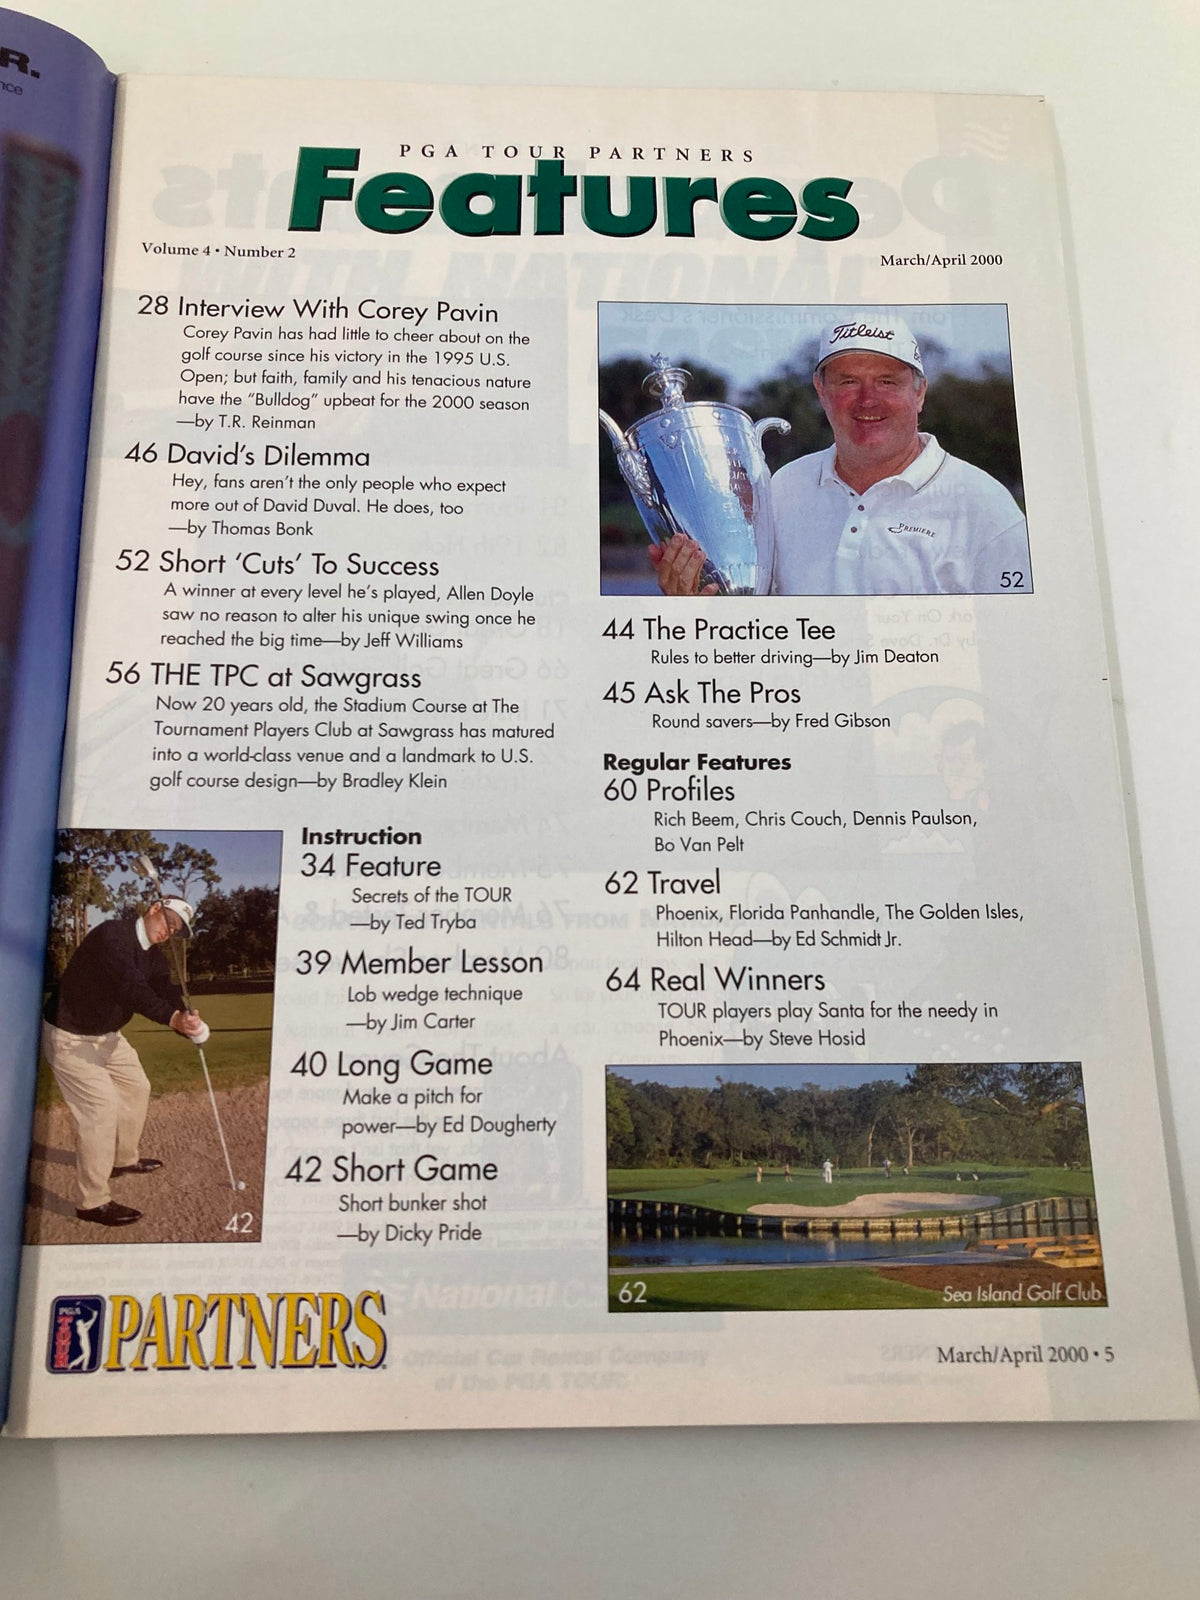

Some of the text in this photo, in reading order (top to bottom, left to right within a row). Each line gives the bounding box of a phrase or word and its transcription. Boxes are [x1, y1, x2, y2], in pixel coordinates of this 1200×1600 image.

[400, 144, 752, 162] PGA TOUR PARTNERS
[288, 146, 860, 242] Features
[142, 243, 295, 258] Volume 4 Number 2
[881, 254, 1002, 268] March/April 2000
[138, 295, 497, 326] 28 Interview With Corey Pavin
[184, 325, 529, 345] Corey Pavin has had little to cheer about on the
[829, 322, 895, 344] Titleist
[182, 346, 509, 366] golf course since his victory in the 1995 U.S.
[125, 442, 157, 463] 46
[265, 442, 369, 466] Dilemma
[171, 497, 463, 516] more out of David Duval. He does, too
[116, 549, 149, 571] 52
[160, 548, 226, 573] Short
[312, 553, 337, 574] To
[347, 553, 439, 576] Success
[1000, 571, 1025, 589] 52
[602, 615, 835, 640] 44 The Practice Tee
[106, 661, 421, 694] 56 THE TPC at Sawgrass
[603, 679, 801, 704] 45 Ask The Pros
[157, 696, 519, 716] Now 20 years old, the Stadium Course at The
[154, 721, 554, 742] Tournament Players Club at Sawgrass has matured
[604, 752, 791, 776] Regular Features
[604, 776, 735, 801] 60 Profiles
[655, 809, 976, 828] Rich Beem, Chris Couch, Dennis Paulson,
[302, 827, 421, 845] Instruction
[655, 836, 744, 851] Bo Van Pelt
[301, 853, 441, 877] 34 Feature
[605, 867, 720, 894] 62 Travel
[352, 886, 511, 903] Secrets of the TOUR
[657, 902, 1023, 922] Phoenix, Florida Panhandle, The Golden Isles,
[296, 946, 542, 975] 39 Member Lesson
[606, 963, 825, 992] 64 Real Winners
[348, 984, 522, 1006] Lob wedge technique
[658, 1001, 997, 1023] TOUR players play Santa for the needy in
[290, 1050, 492, 1084] 40 Long Game
[285, 1152, 498, 1182] 42 Short Game
[339, 1192, 487, 1212] Short bunker shot
[225, 1213, 253, 1234] 42
[618, 1282, 647, 1304] 62
[943, 1281, 1102, 1303] Sea Island Golf Club
[103, 1290, 387, 1372] PARTNERS
[938, 1345, 1114, 1367] March/April 2000 5
